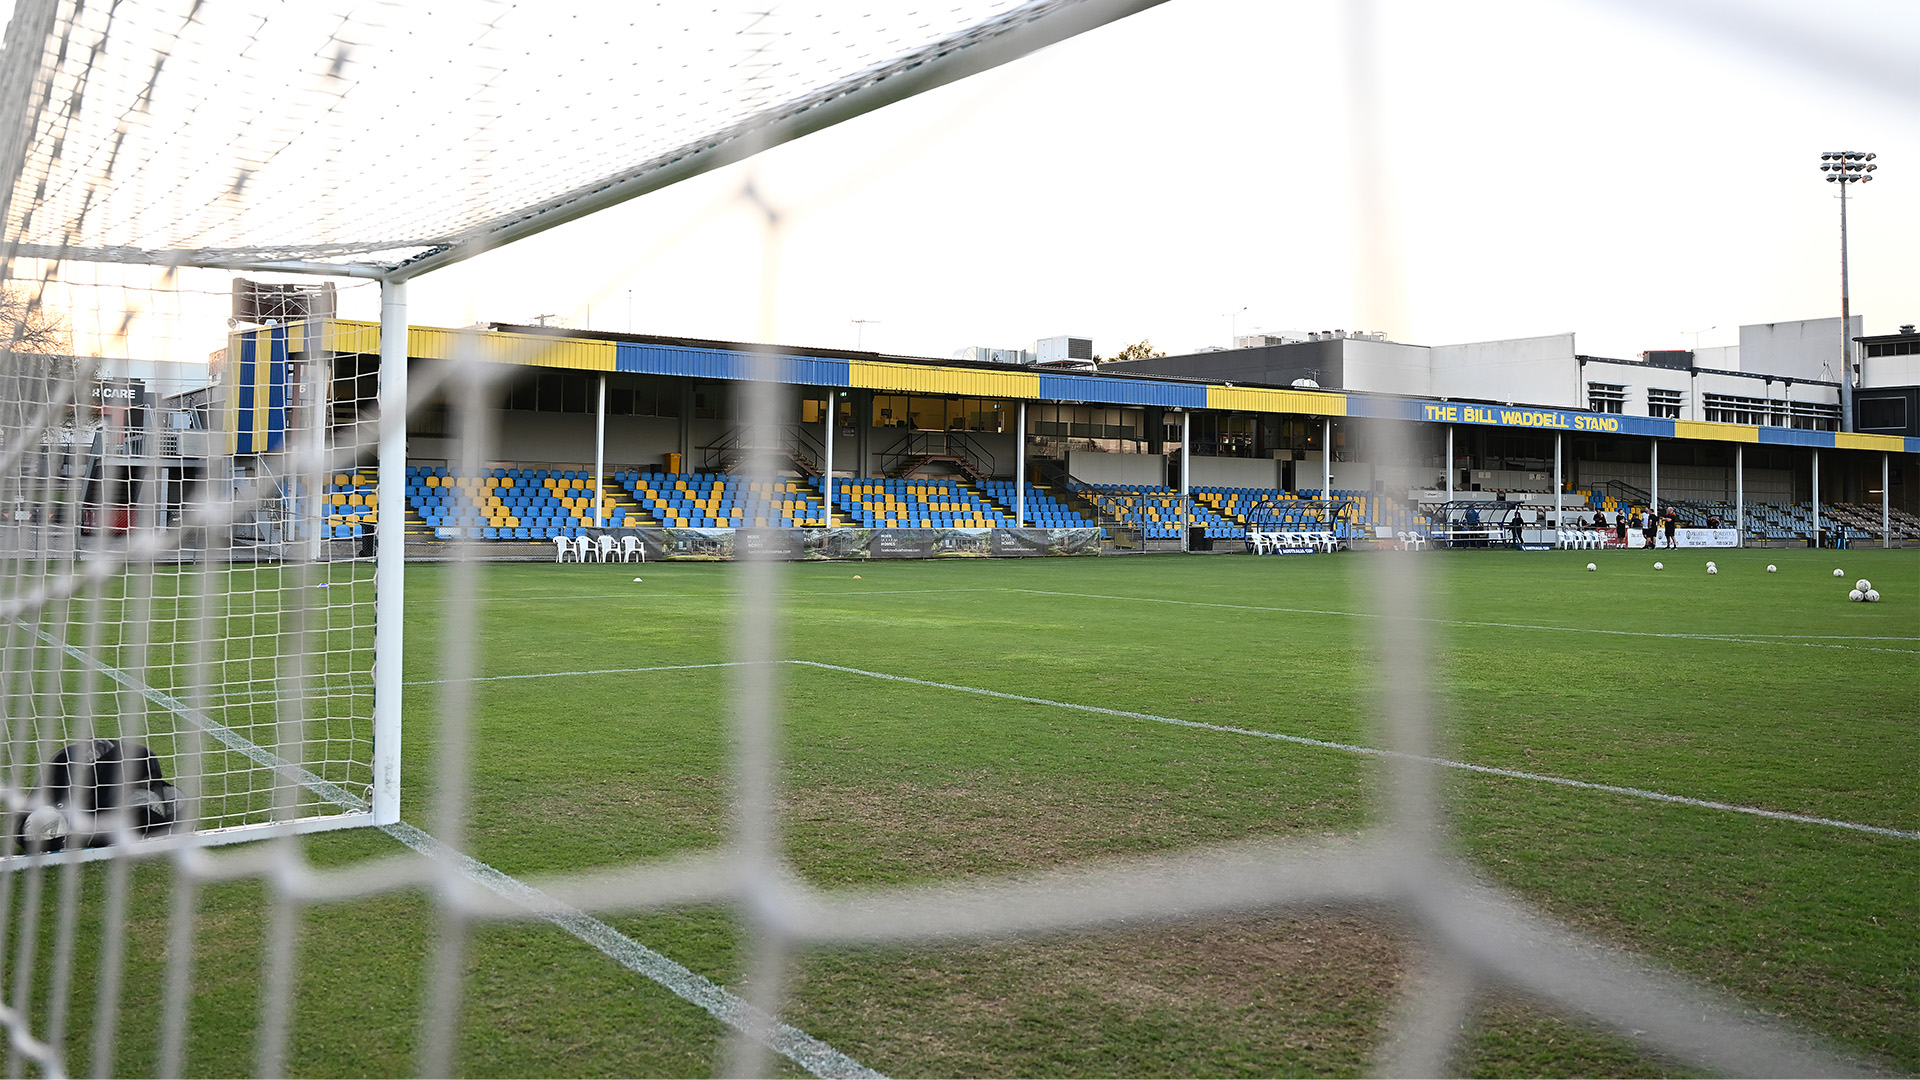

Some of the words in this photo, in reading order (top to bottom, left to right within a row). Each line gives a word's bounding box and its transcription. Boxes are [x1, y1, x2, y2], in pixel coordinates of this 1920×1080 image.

[103, 388, 136, 399] CARE
[1424, 405, 1458, 422] THE
[1463, 407, 1498, 424] BILL
[1500, 410, 1569, 429] WADDELL
[1574, 415, 1619, 432] STAND
